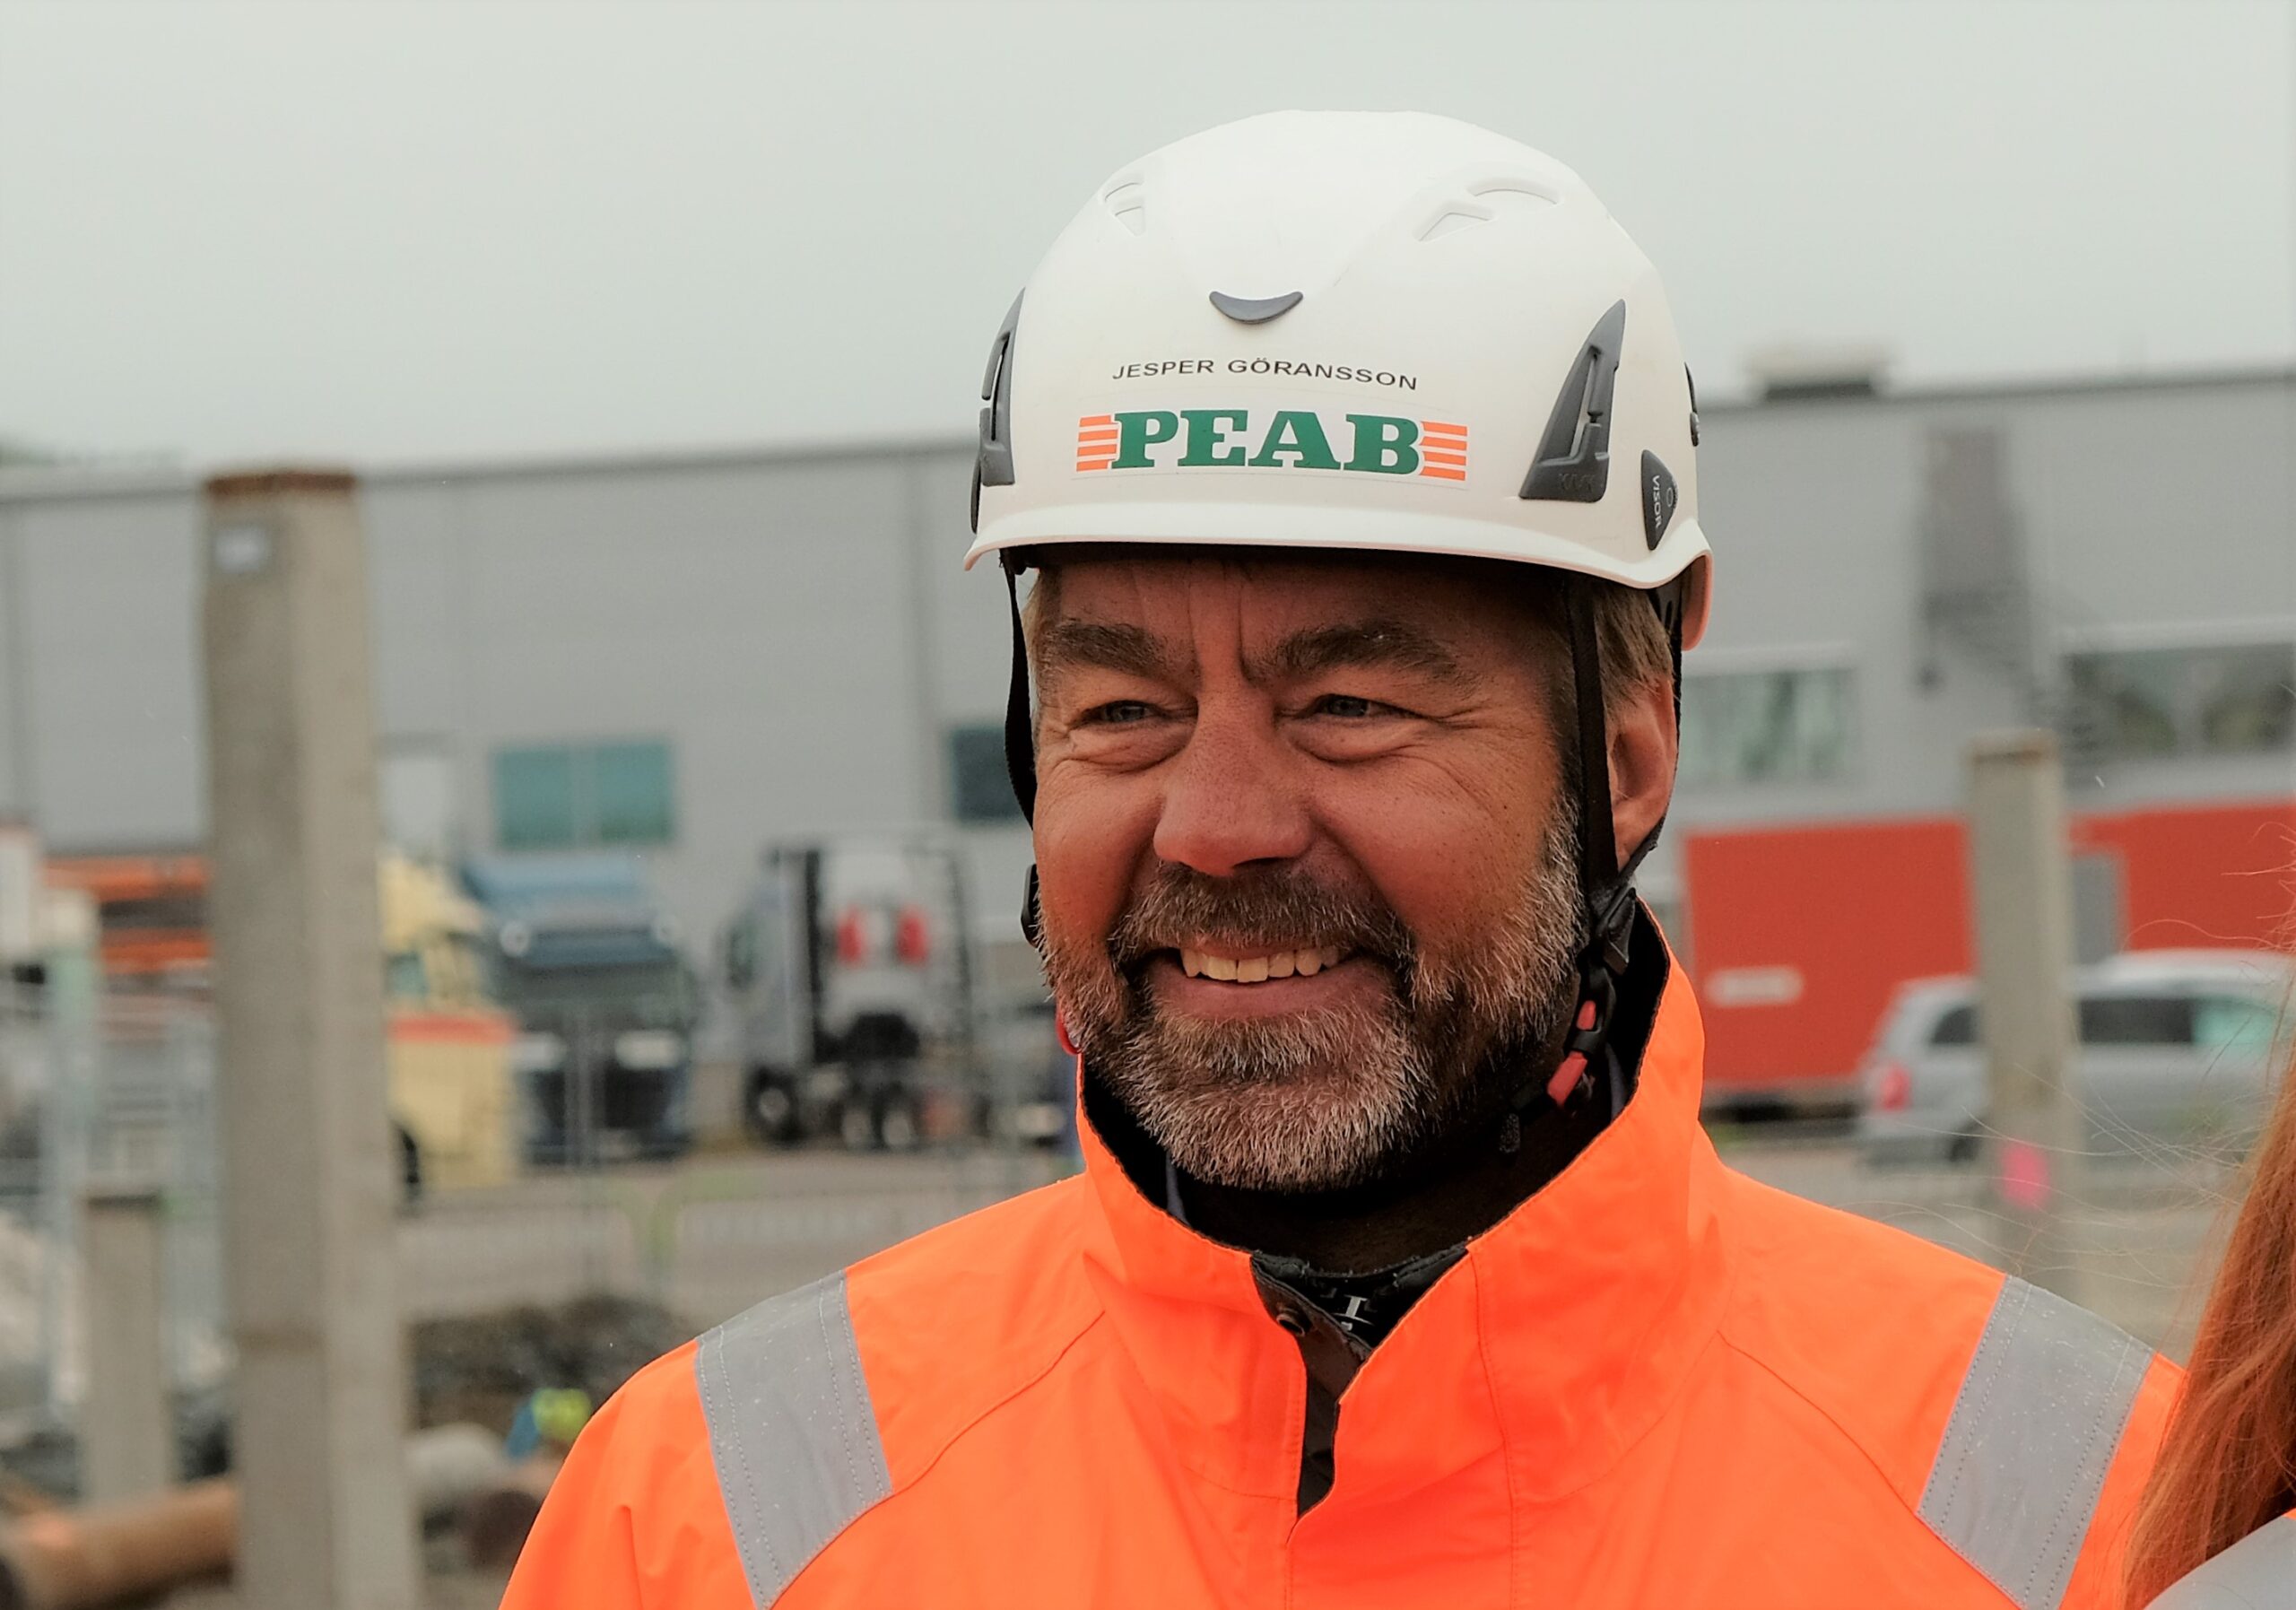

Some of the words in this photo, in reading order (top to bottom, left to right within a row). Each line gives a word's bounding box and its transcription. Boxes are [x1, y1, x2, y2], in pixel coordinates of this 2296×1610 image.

[1112, 359, 1214, 379] JESPER
[1227, 357, 1418, 390] GÖRANSSON
[1111, 410, 1420, 475] PEAB
[1652, 474, 1662, 529] VISOR
